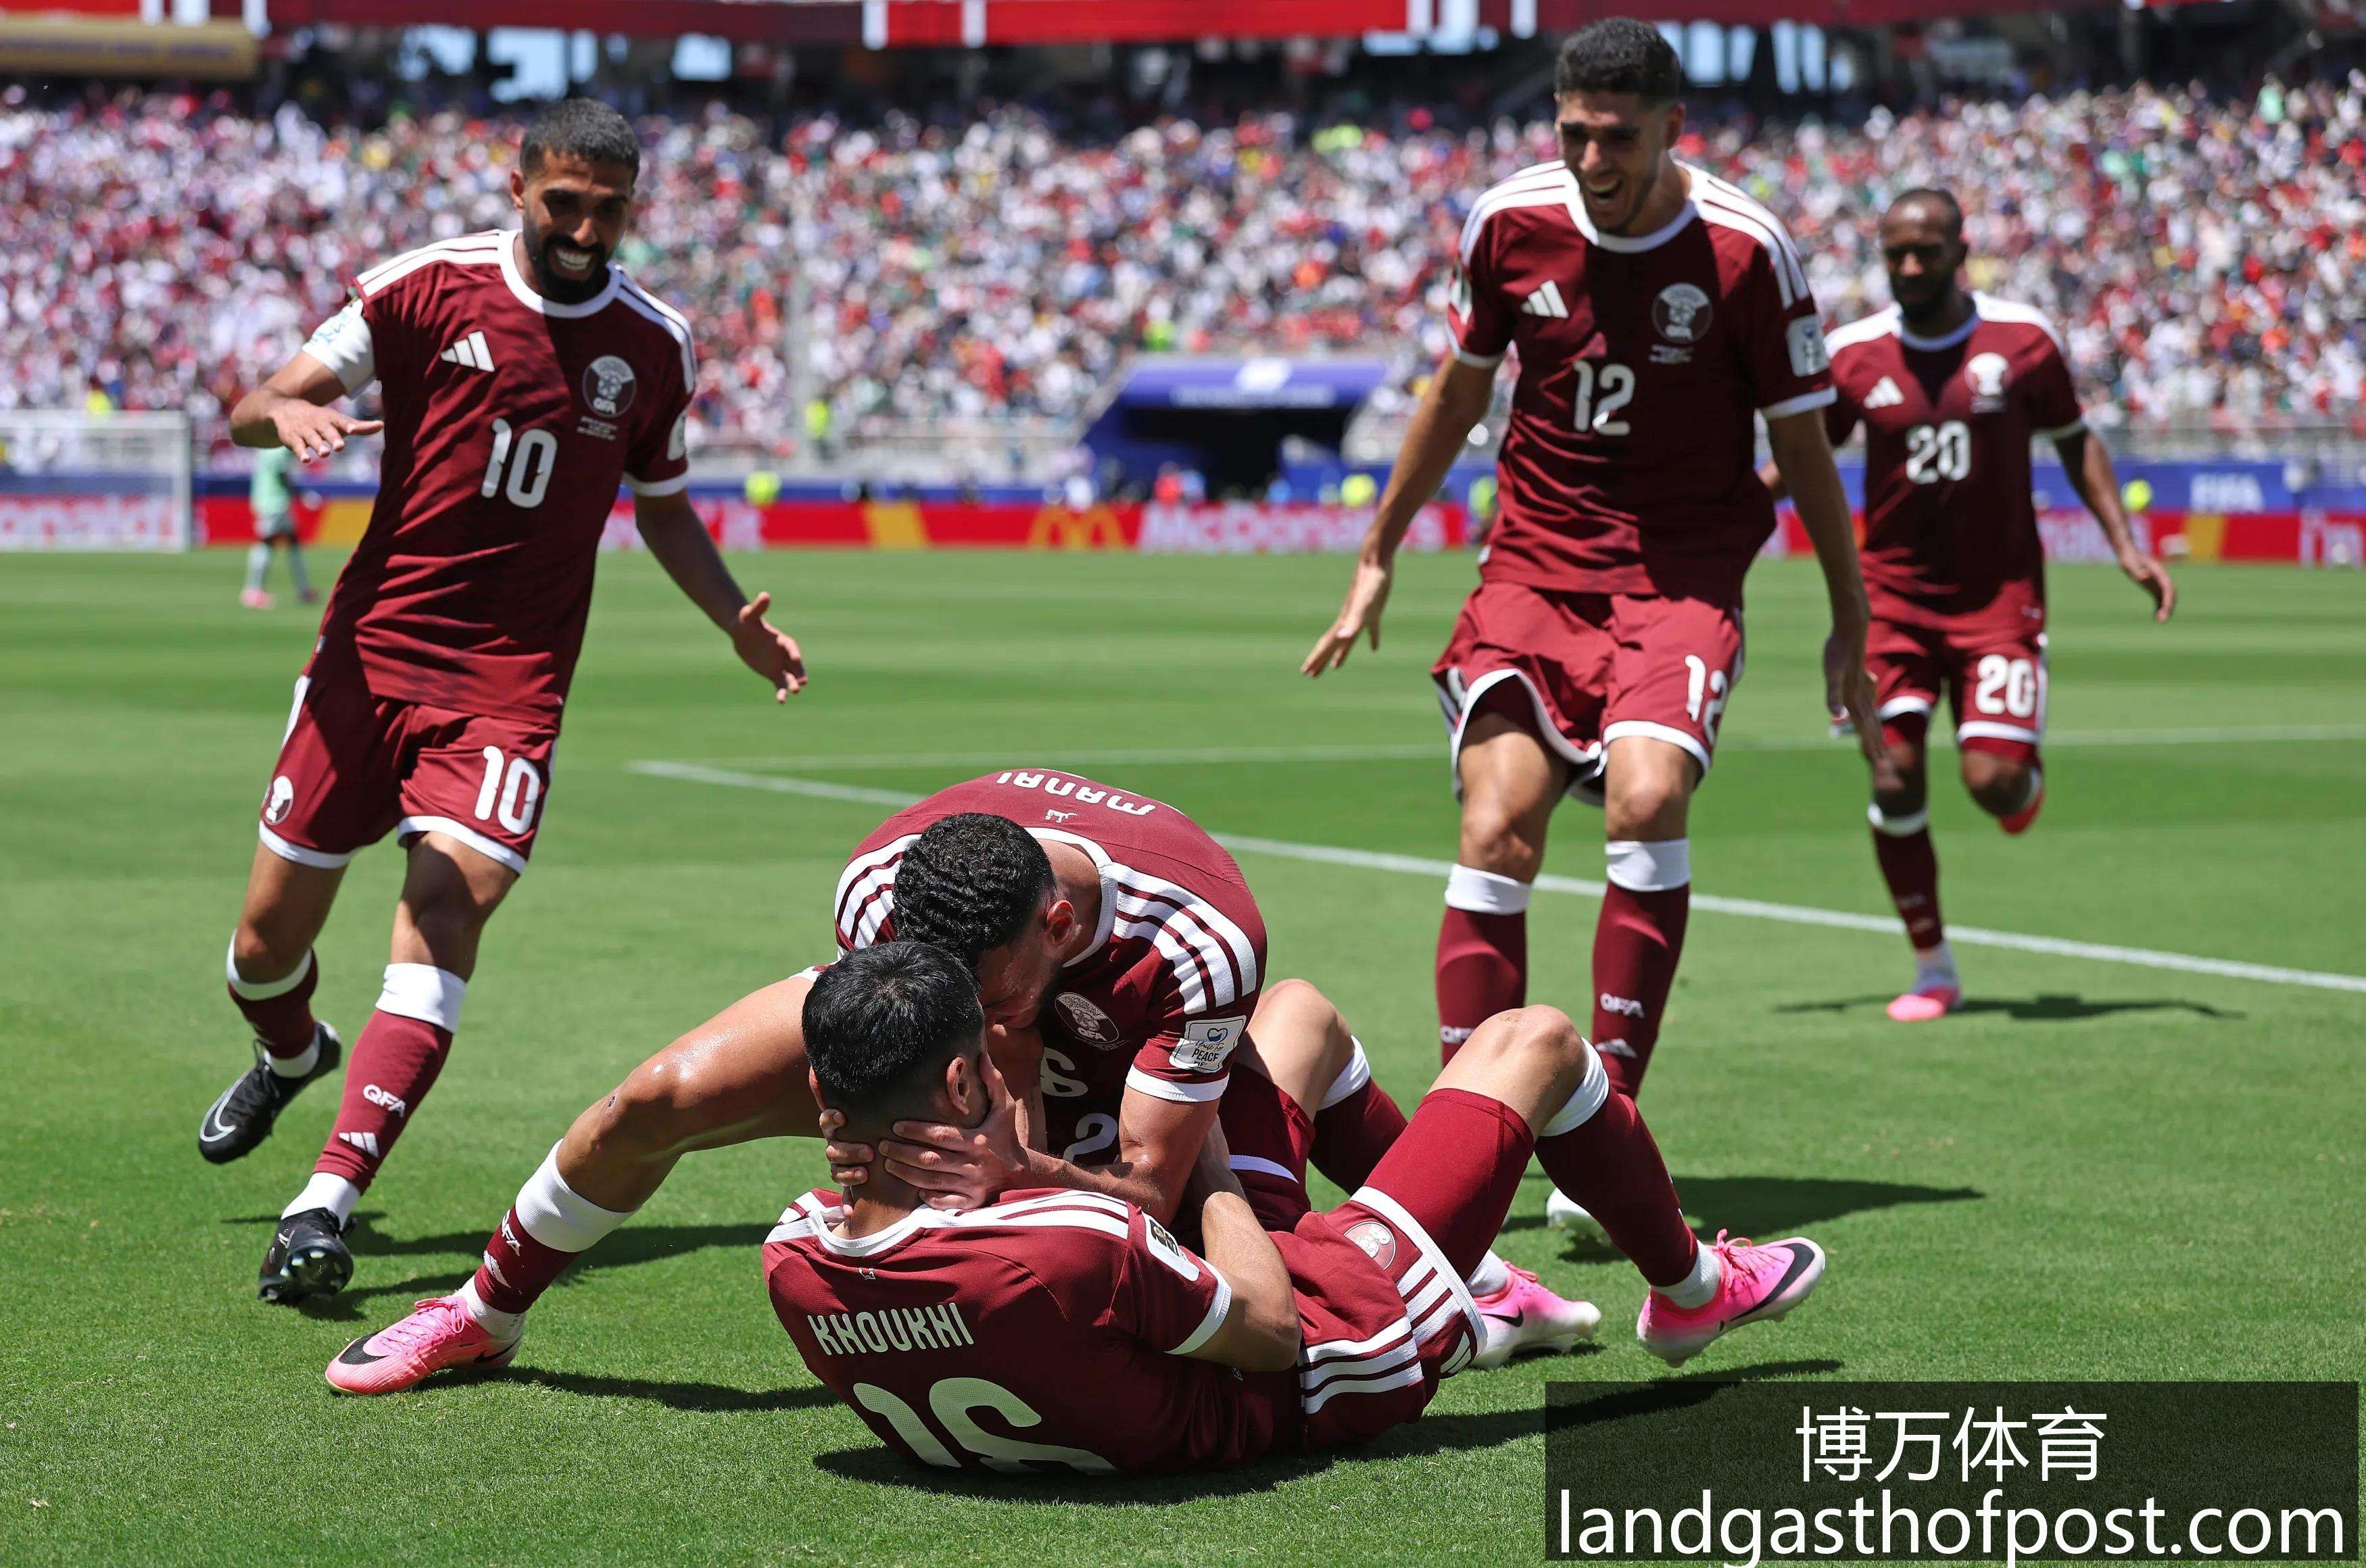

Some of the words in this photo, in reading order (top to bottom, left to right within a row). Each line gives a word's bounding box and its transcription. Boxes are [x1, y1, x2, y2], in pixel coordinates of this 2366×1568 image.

[1573, 360, 1635, 436] 12
[481, 418, 558, 508] 10
[1906, 420, 1971, 485] 20
[1683, 653, 1728, 744] 12
[1974, 653, 2037, 718] 20
[474, 745, 541, 836] 10
[1439, 1025, 1474, 1044] QF
[1599, 992, 1645, 1019] QFA
[1194, 1040, 1215, 1051] Unite
[362, 1083, 407, 1118] QFA
[807, 1302, 974, 1356] KHOUKHI
